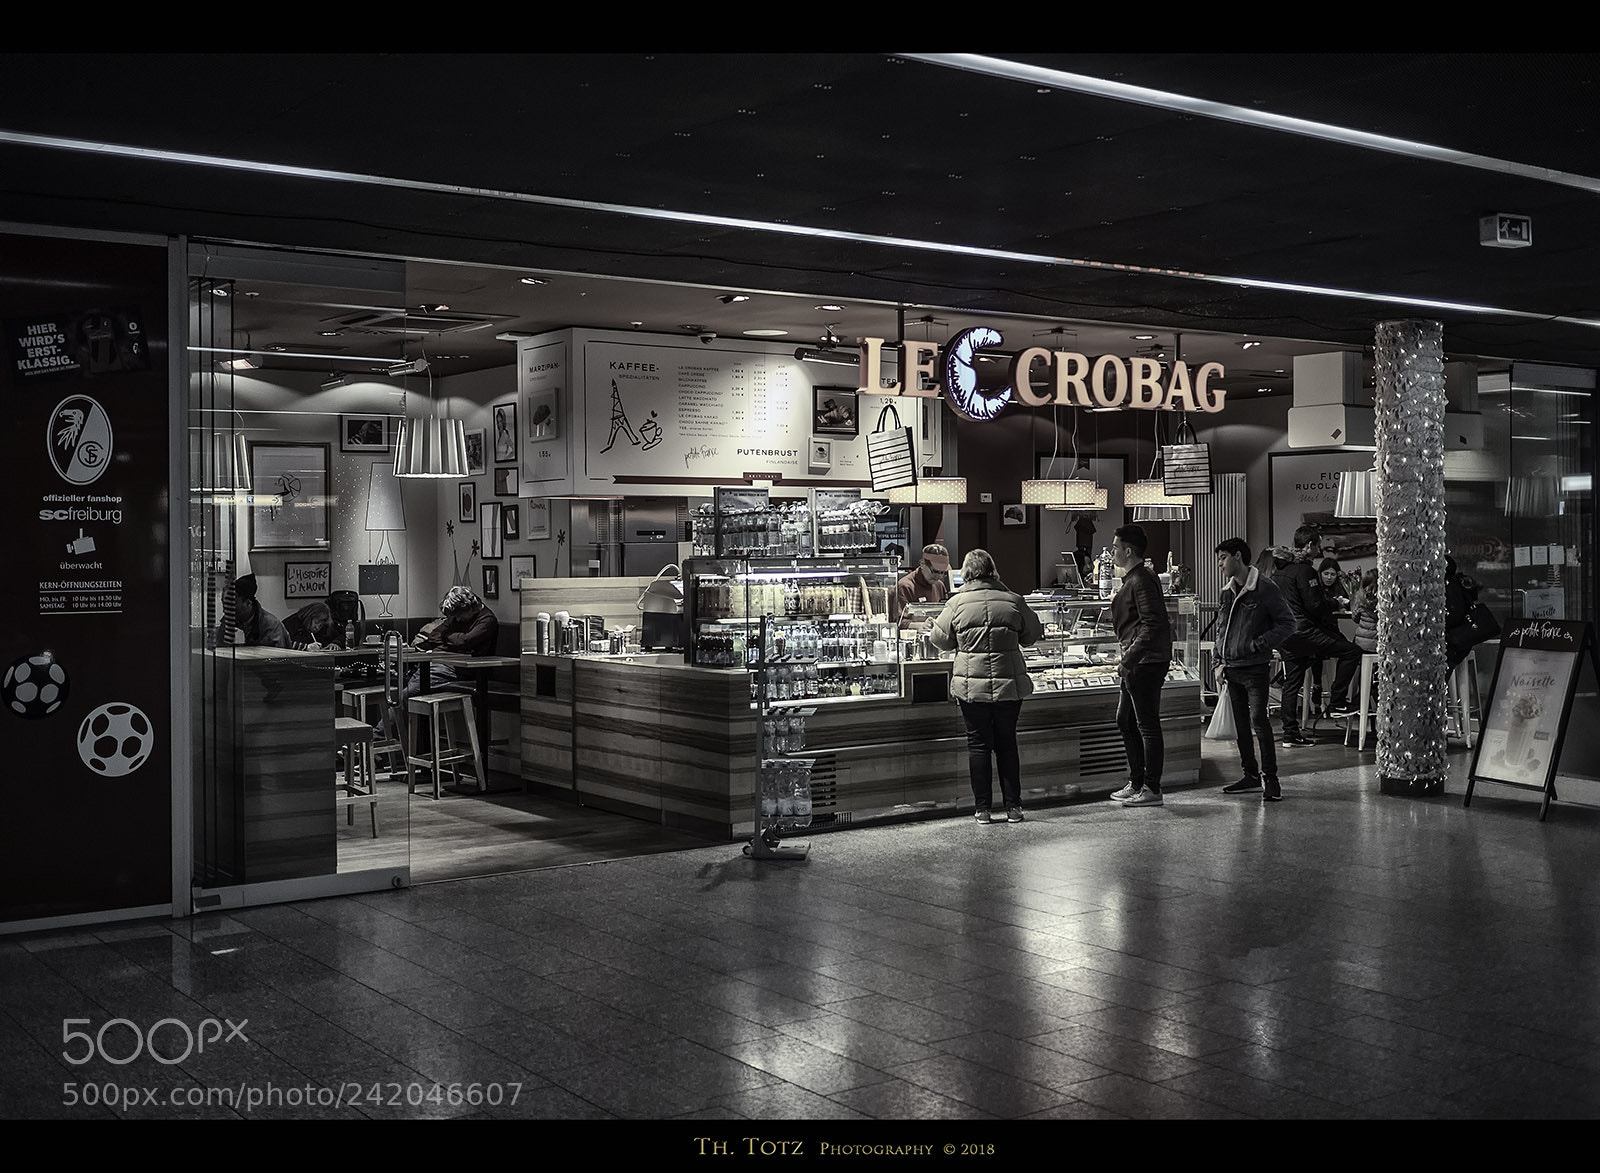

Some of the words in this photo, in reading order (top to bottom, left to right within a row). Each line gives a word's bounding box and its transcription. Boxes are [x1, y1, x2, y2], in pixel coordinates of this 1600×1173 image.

[27, 323, 57, 336] HIER
[18, 334, 66, 348] WIRD'S
[26, 345, 62, 359] ERST-
[17, 355, 75, 370] KLASSIG.
[609, 361, 659, 372] KAFFEE-
[856, 336, 941, 398] LE
[1014, 348, 1228, 413] CROBAG
[736, 448, 798, 457] PUTENBRUST
[1295, 482, 1338, 490] RUCOLA
[43, 494, 86, 503] offizieller
[87, 495, 122, 504] fanshop
[60, 561, 103, 570] überwacht
[39, 580, 122, 589] KERN-ÖFFNUNGSZEITEN
